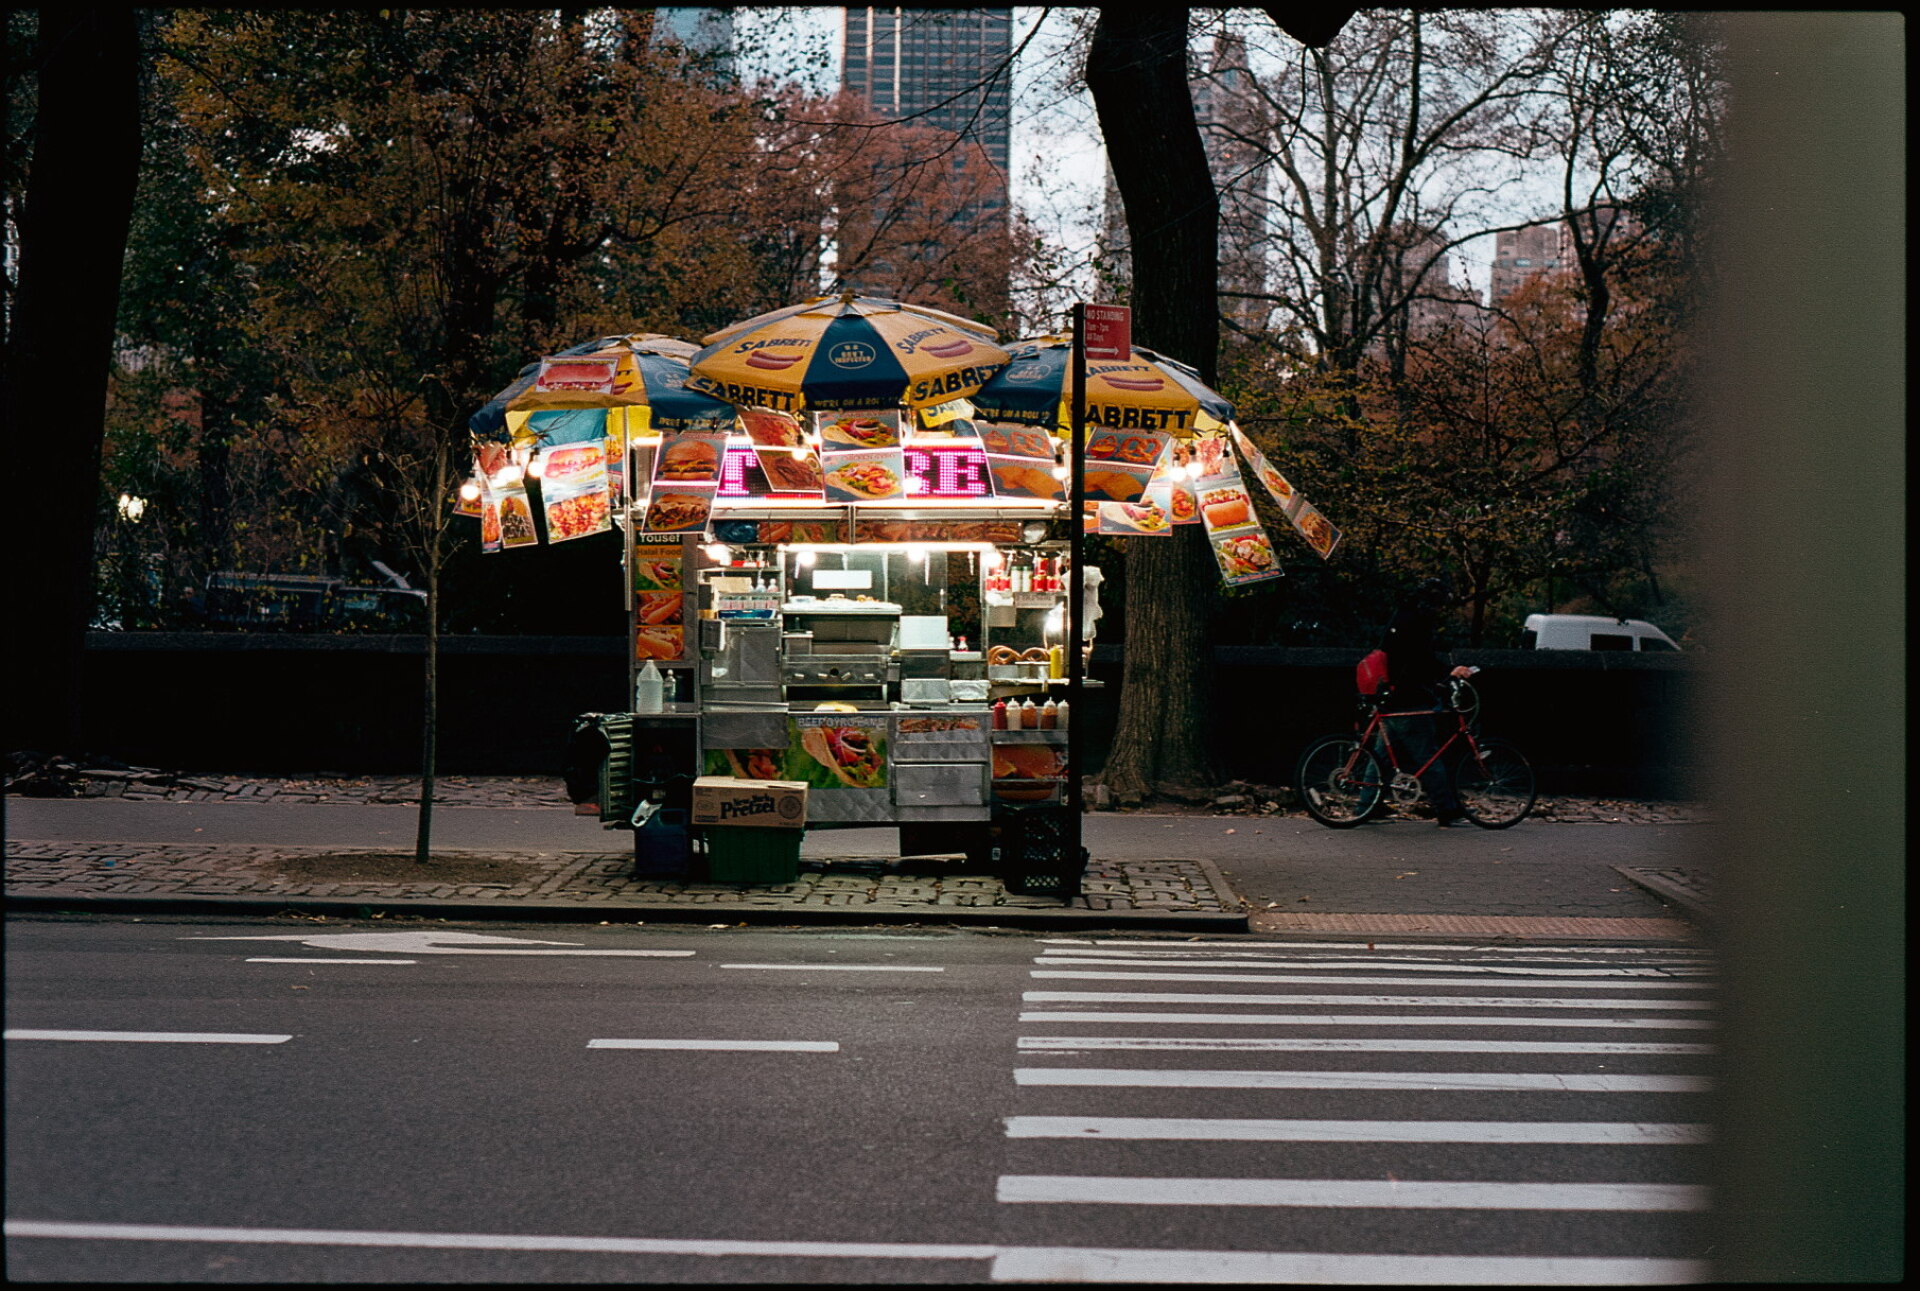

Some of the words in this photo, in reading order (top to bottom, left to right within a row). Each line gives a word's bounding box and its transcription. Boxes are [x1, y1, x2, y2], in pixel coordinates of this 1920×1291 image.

[1086, 309, 1096, 320] NO
[1097, 310, 1124, 321] STANDING
[734, 338, 812, 354] SABRETT
[895, 327, 947, 355] SABRETT
[1085, 364, 1151, 378] ABRETT
[693, 377, 796, 412] SABRETT
[1084, 403, 1192, 434] ABRETT
[720, 796, 776, 819] Pretzel
